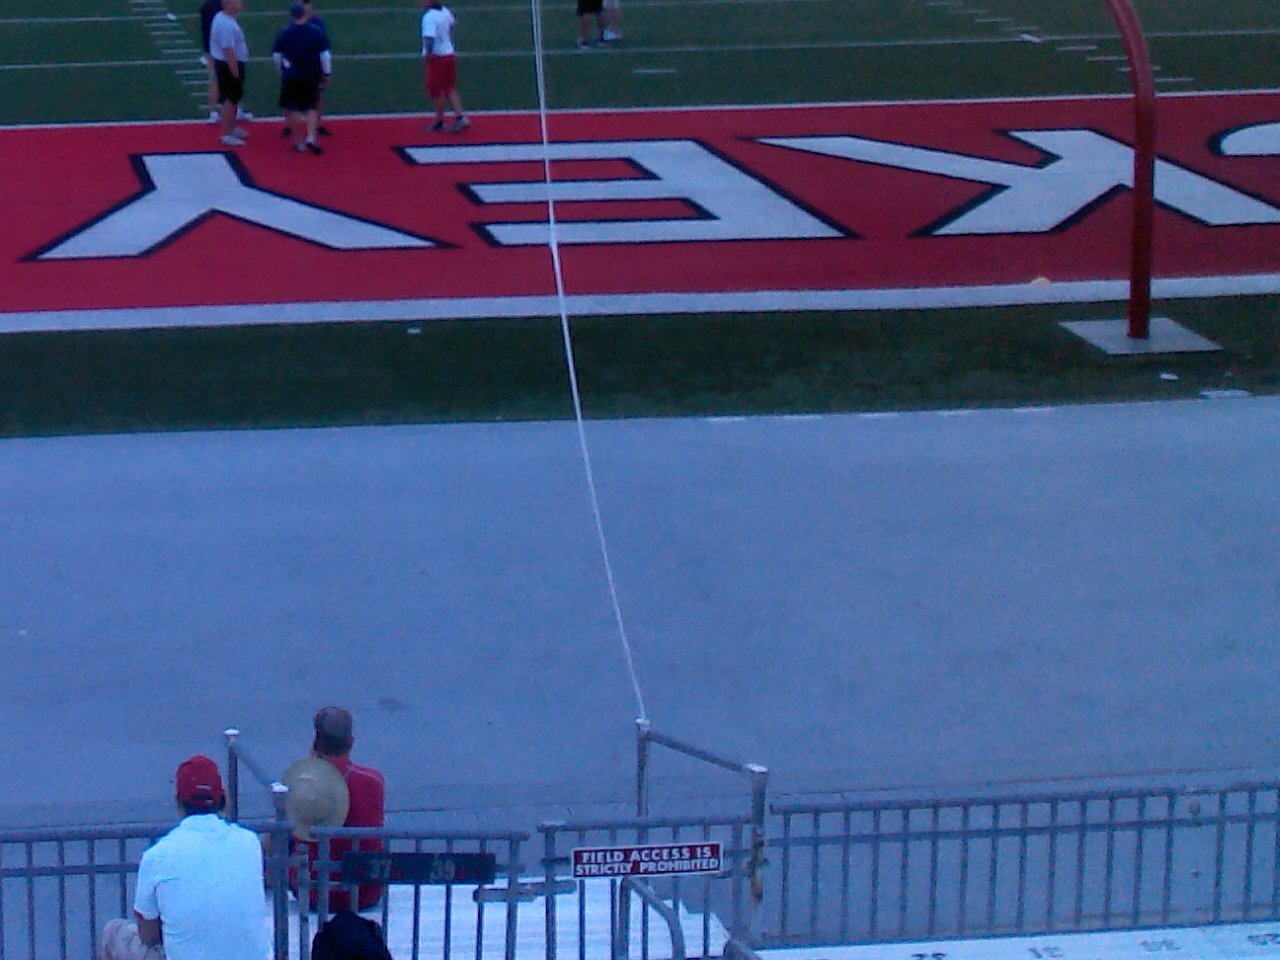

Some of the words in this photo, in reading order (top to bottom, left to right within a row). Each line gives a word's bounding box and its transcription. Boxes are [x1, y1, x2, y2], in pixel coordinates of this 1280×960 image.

[582, 851, 625, 864] FIELD
[630, 847, 691, 862] ACCESS
[696, 845, 712, 858] IS
[575, 863, 634, 877] STRICTLY
[639, 858, 718, 875] PROHIBITED
